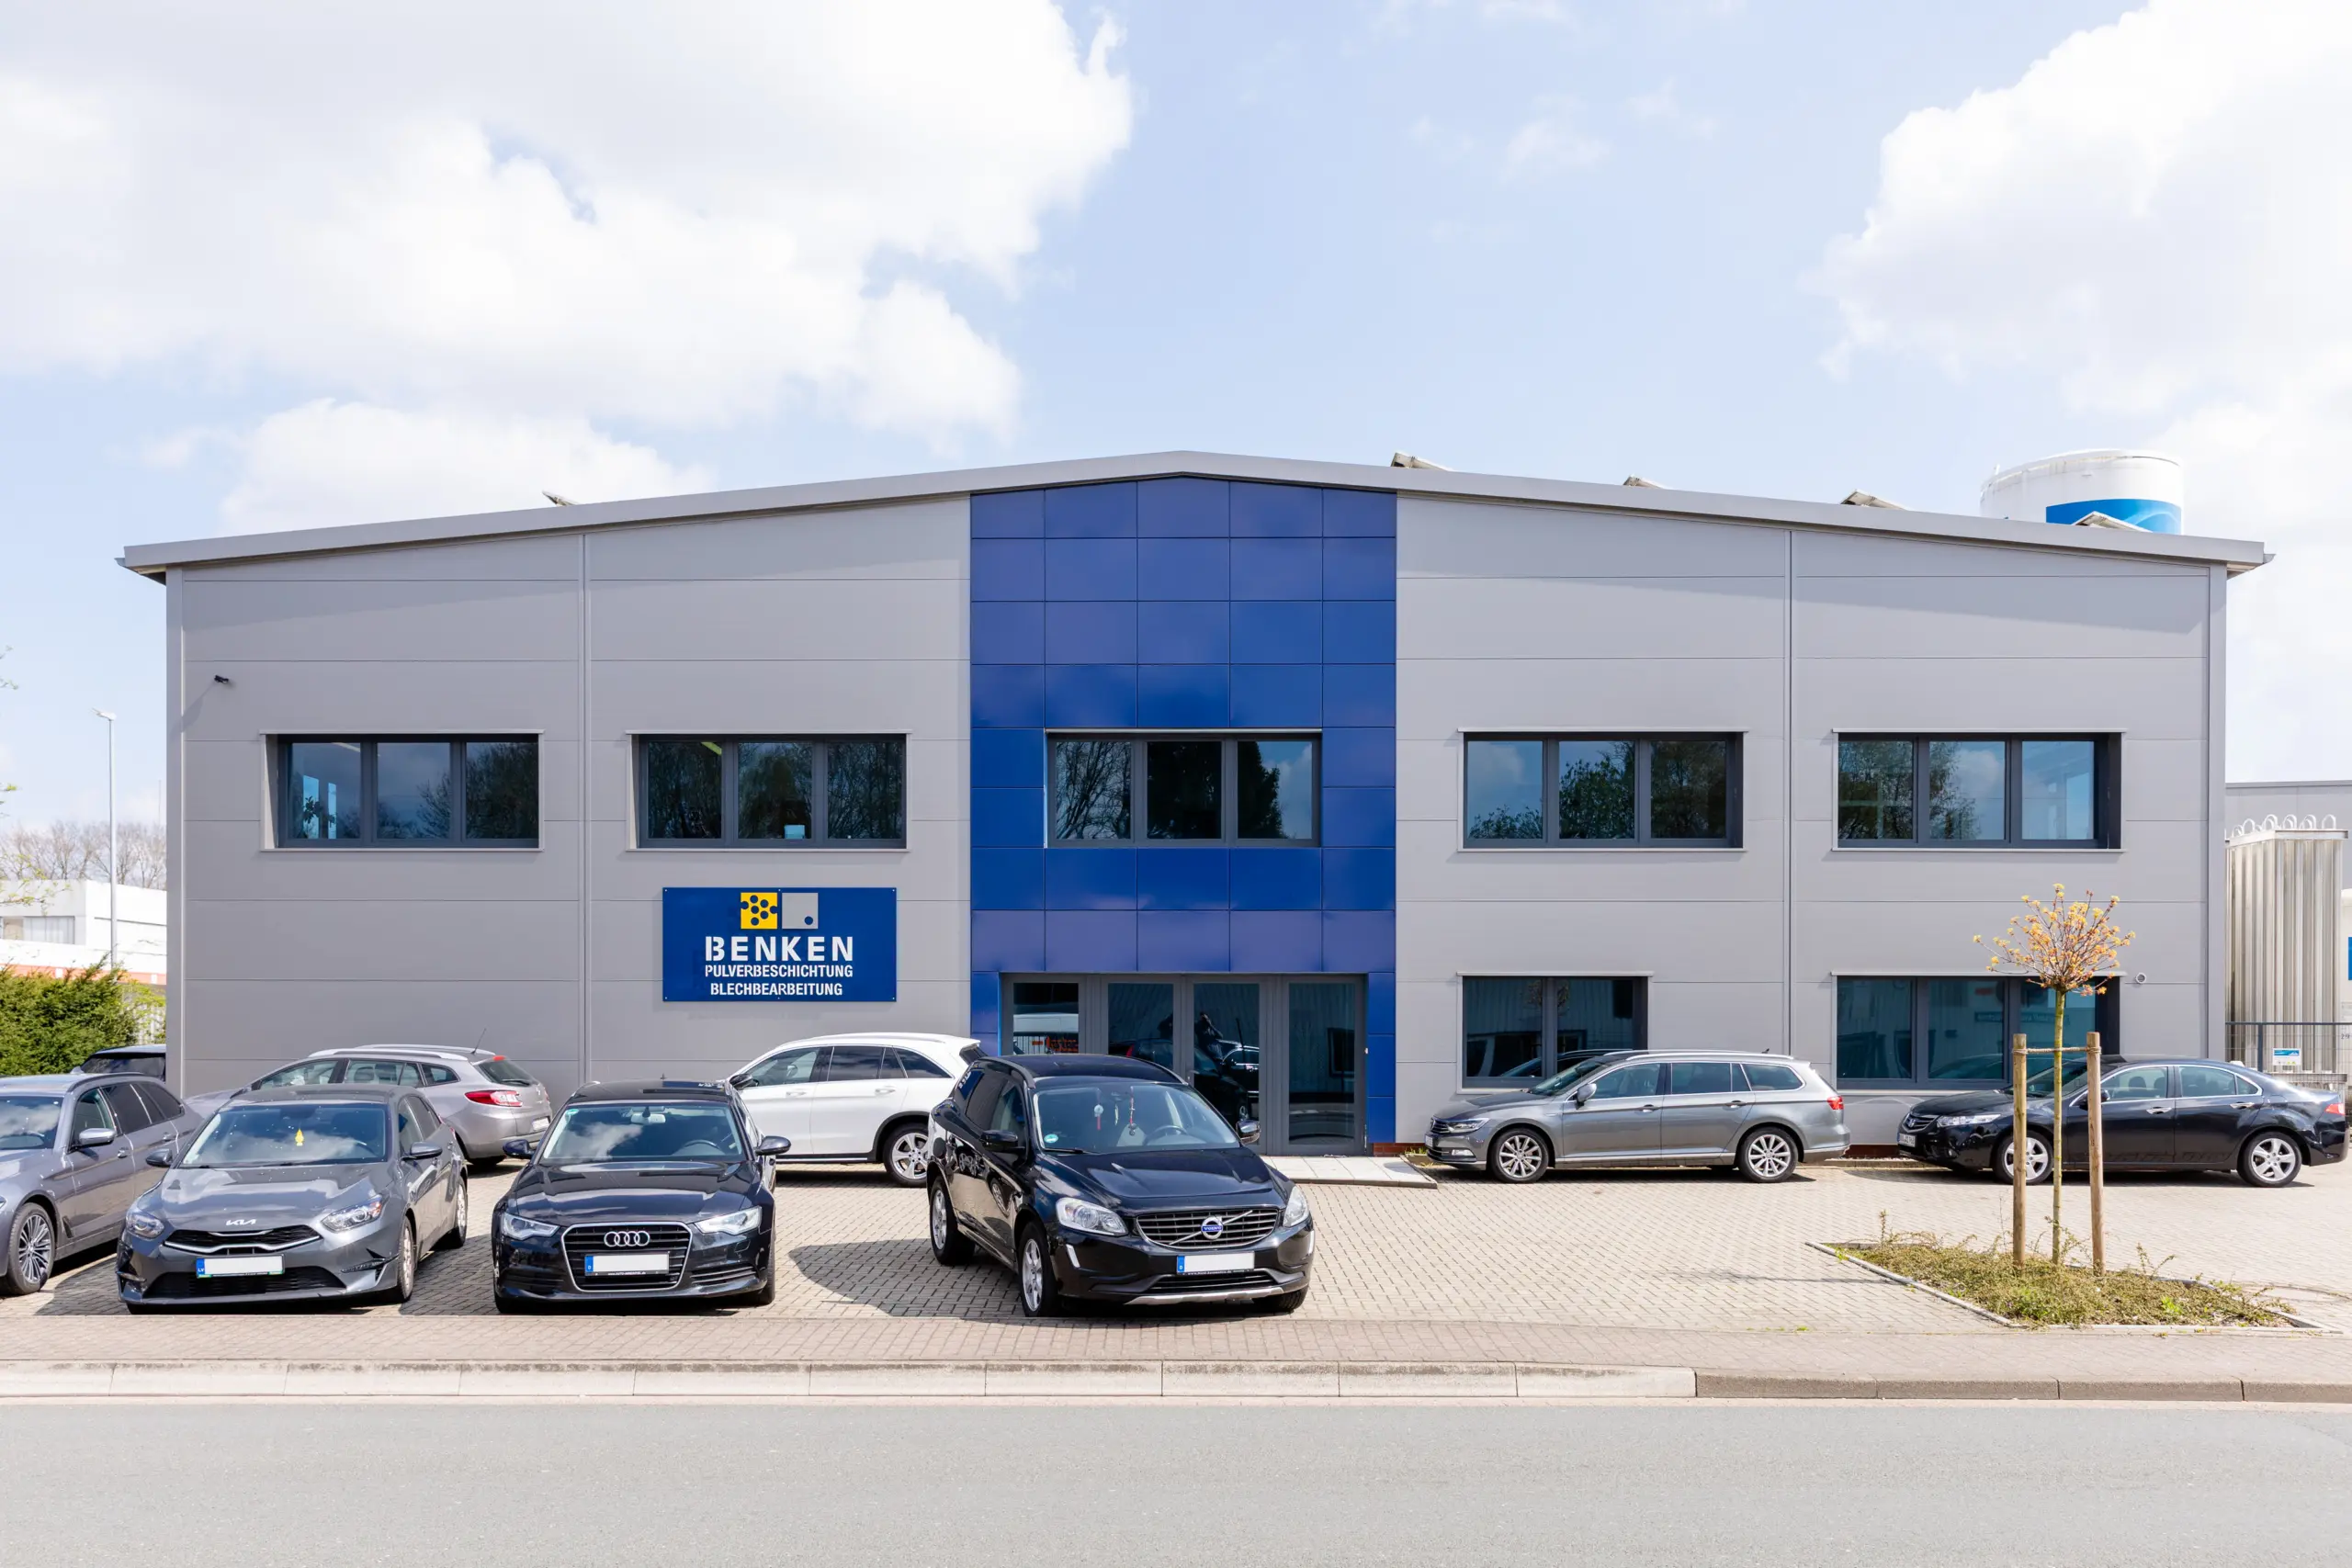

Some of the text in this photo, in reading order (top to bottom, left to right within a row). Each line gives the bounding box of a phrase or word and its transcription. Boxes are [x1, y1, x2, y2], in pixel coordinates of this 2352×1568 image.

[705, 936, 854, 962] BENKEN
[705, 964, 854, 977] PULVERBESCHICHTUNG
[710, 983, 843, 996] BLECHBEARBEITUNG
